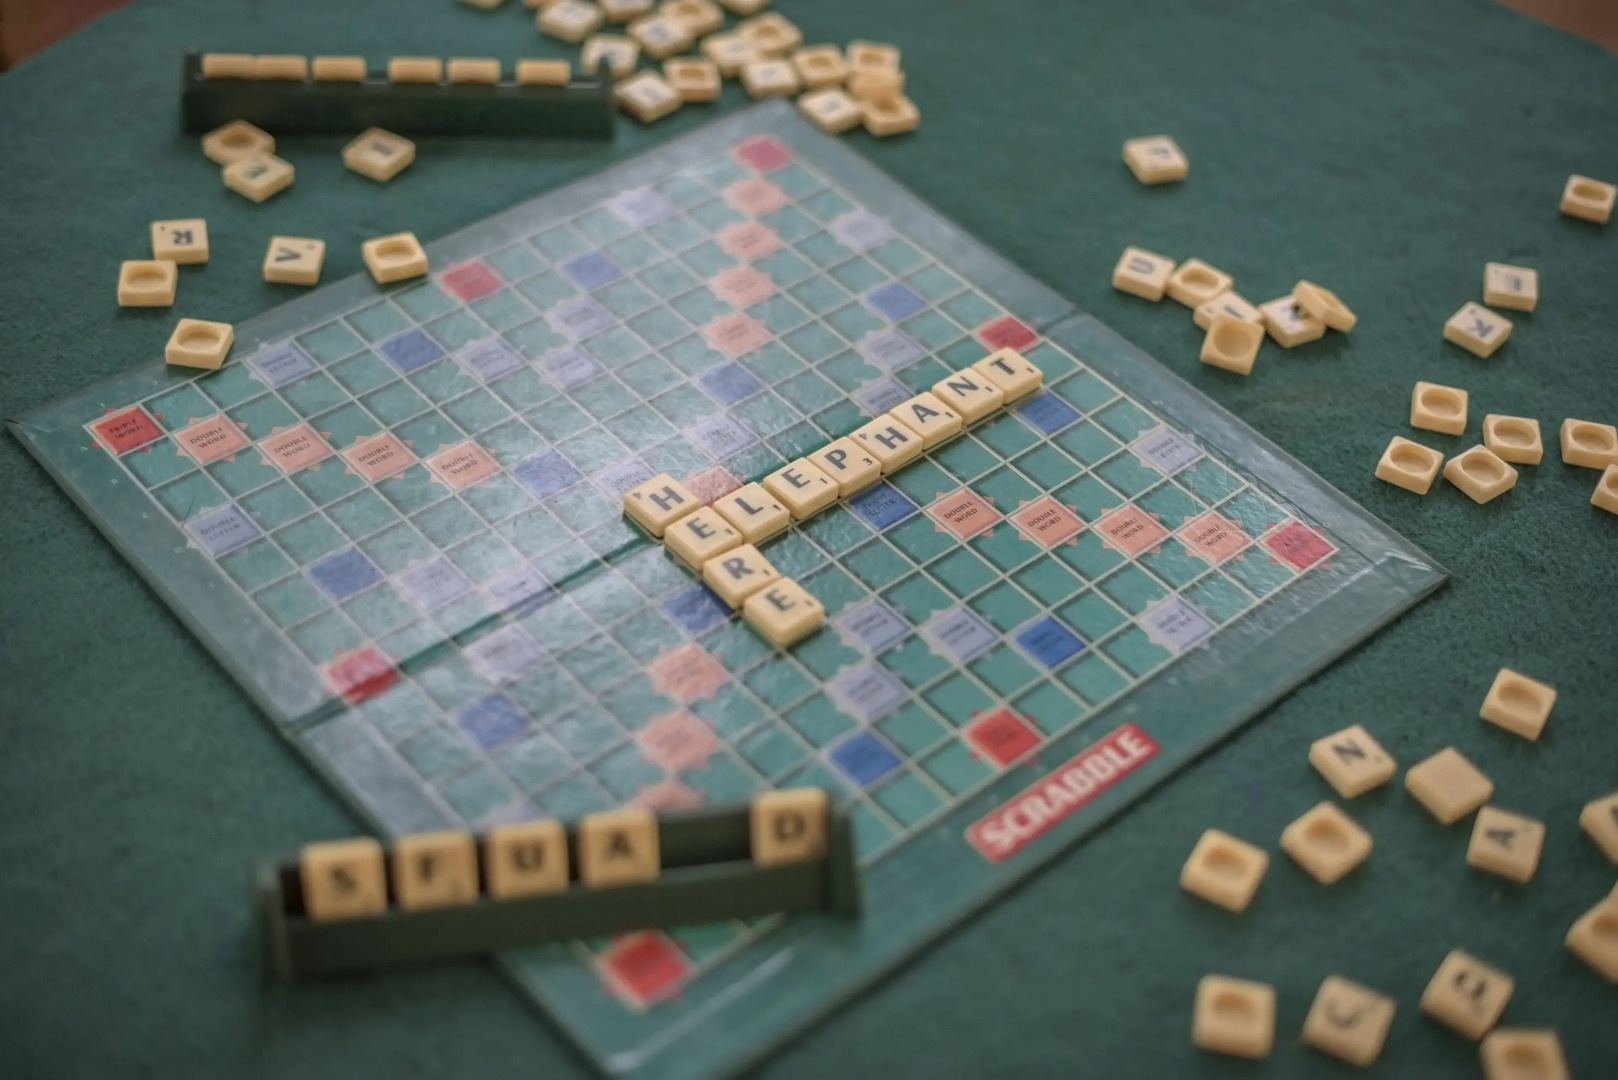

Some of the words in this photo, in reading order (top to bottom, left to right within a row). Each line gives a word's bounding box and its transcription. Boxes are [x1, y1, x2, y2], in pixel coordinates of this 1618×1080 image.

[108, 418, 138, 434] TRIPLE
[114, 424, 144, 440] WORD
[188, 426, 224, 444] DOUBLE
[198, 433, 227, 449] WORD
[273, 435, 308, 454] DOUBLE
[282, 442, 312, 458] WORD
[357, 443, 391, 462] DOUBLE
[366, 451, 395, 467] WORD
[441, 452, 475, 471] DOUBLE
[450, 459, 479, 475] WORD
[943, 500, 974, 520] DOUBLE
[953, 507, 978, 524] WORD
[1026, 508, 1057, 528] DOUBLE
[200, 516, 236, 536] DOUBLE
[1037, 515, 1062, 533] WORD
[1110, 516, 1139, 537] DOUBLE
[1120, 523, 1146, 541] WORD
[1193, 523, 1222, 544] DOUBLE
[1203, 531, 1228, 548] WORD
[980, 729, 1151, 851] SCRABBLE
